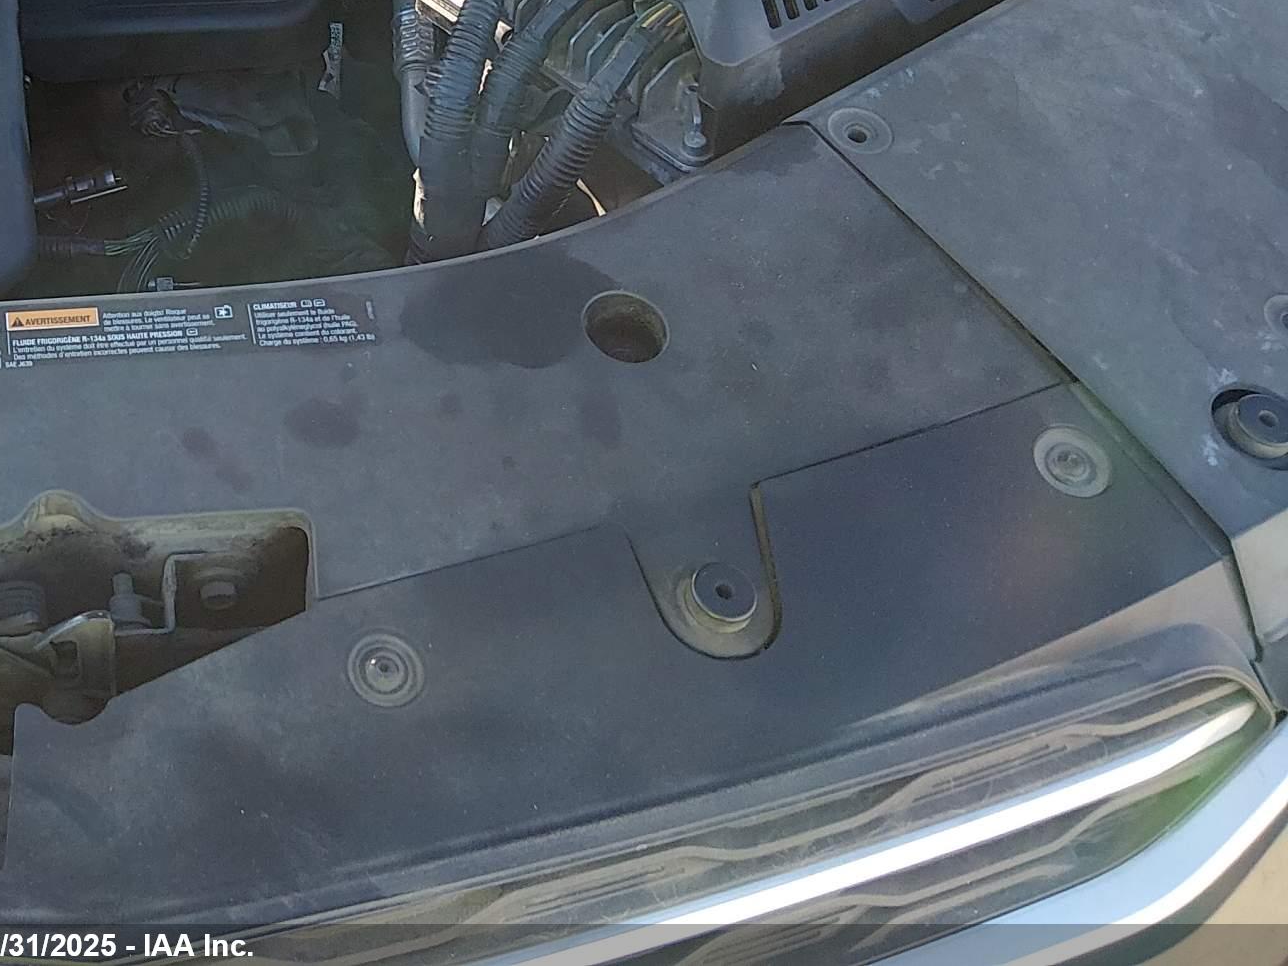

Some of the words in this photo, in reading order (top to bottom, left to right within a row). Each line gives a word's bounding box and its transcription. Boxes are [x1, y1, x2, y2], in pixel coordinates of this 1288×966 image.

[253, 301, 297, 311] CLIMATISEUR
[25, 315, 91, 326] AVERTISSEMENT
[12, 337, 37, 346] FLUIDE
[37, 334, 82, 345] FRIGORIGÈNE
[82, 335, 106, 343] R-134a
[107, 333, 126, 341] SOUS
[126, 331, 149, 340] HAUTE
[149, 330, 183, 339] PRESSION
